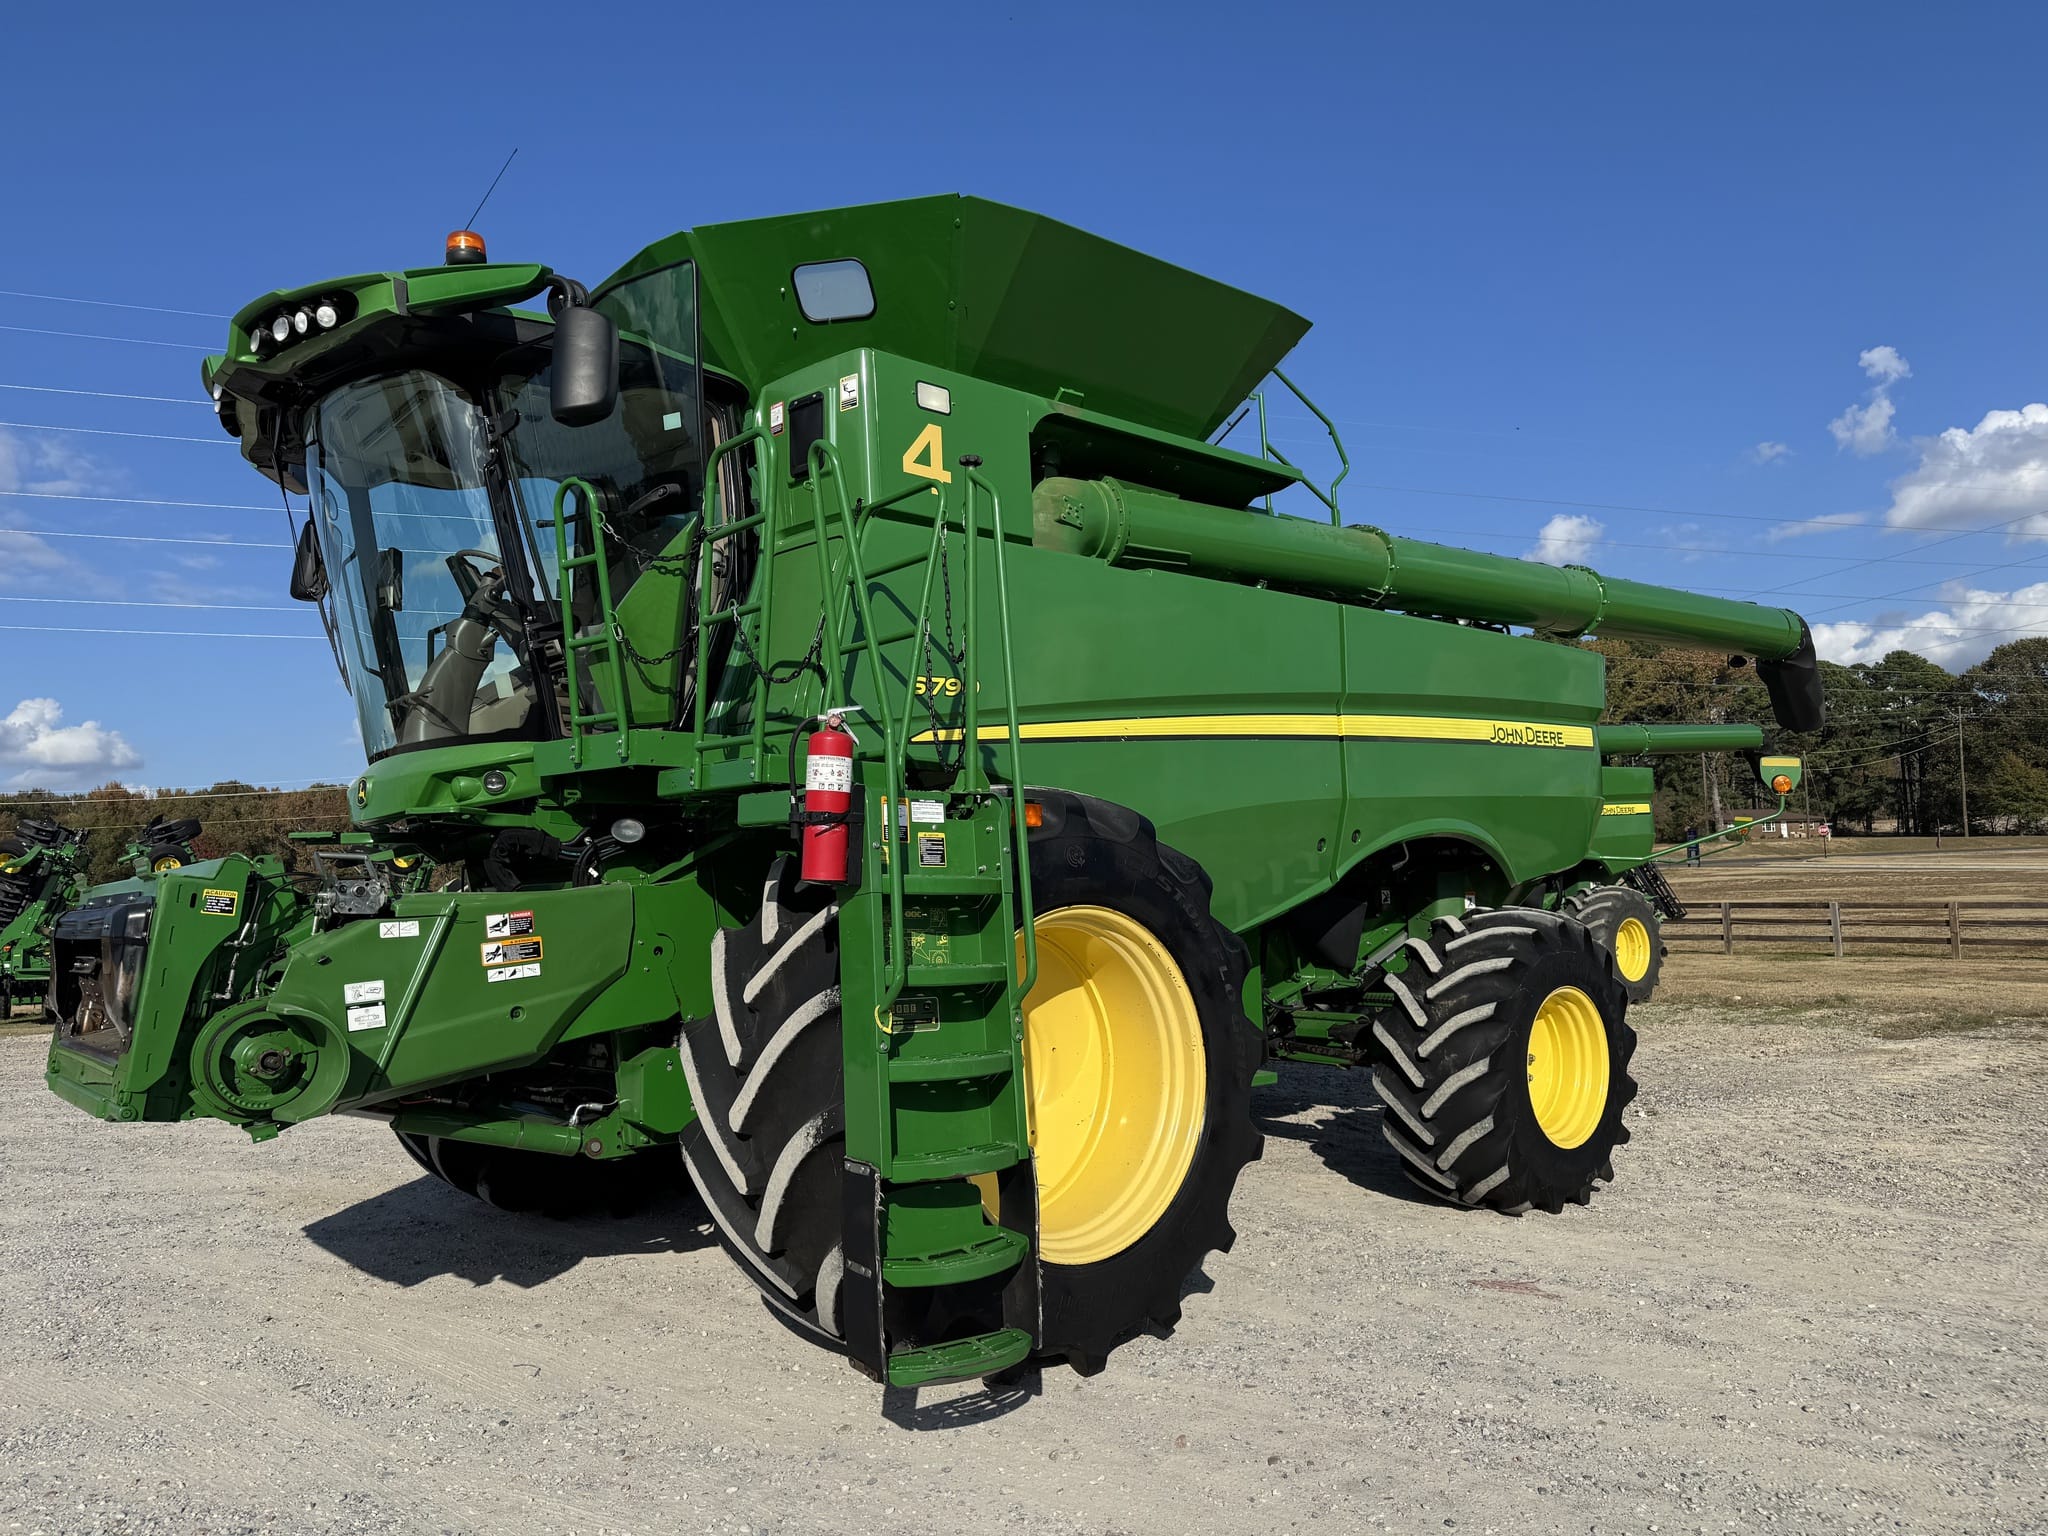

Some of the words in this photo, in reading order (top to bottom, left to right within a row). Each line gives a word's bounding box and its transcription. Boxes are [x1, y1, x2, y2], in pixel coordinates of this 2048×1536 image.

[903, 423, 952, 495] 4
[914, 675, 981, 696] S79
[1490, 723, 1523, 743] JOHN
[1525, 727, 1565, 745] DEERE
[1602, 807, 1615, 815] OHN
[1616, 805, 1635, 814] DEERE
